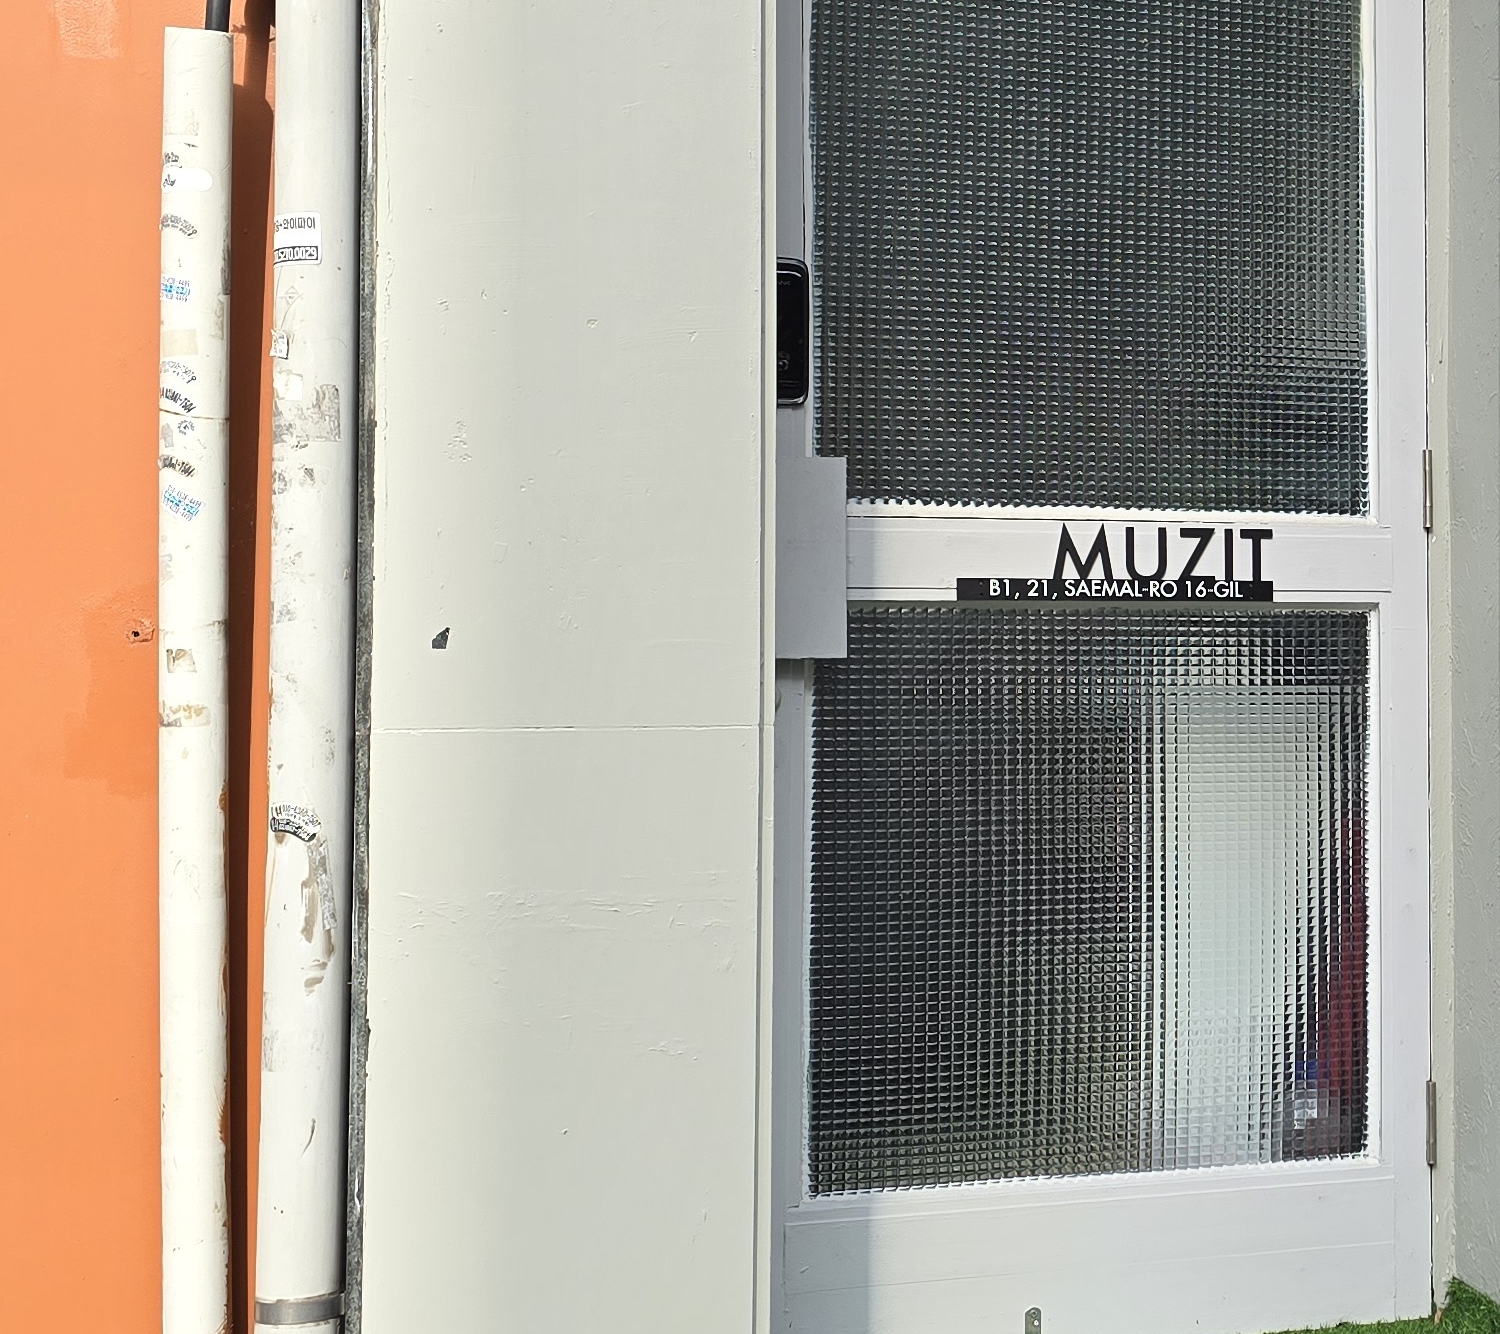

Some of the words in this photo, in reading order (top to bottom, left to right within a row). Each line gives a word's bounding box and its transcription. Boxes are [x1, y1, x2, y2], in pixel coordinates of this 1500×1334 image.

[1053, 522, 1273, 581] MUZIT
[989, 578, 1019, 600] B1,
[1026, 579, 1058, 600] 21,
[1064, 578, 1178, 598] SAEMAL-RO
[1185, 580, 1243, 598] 16-GIL
